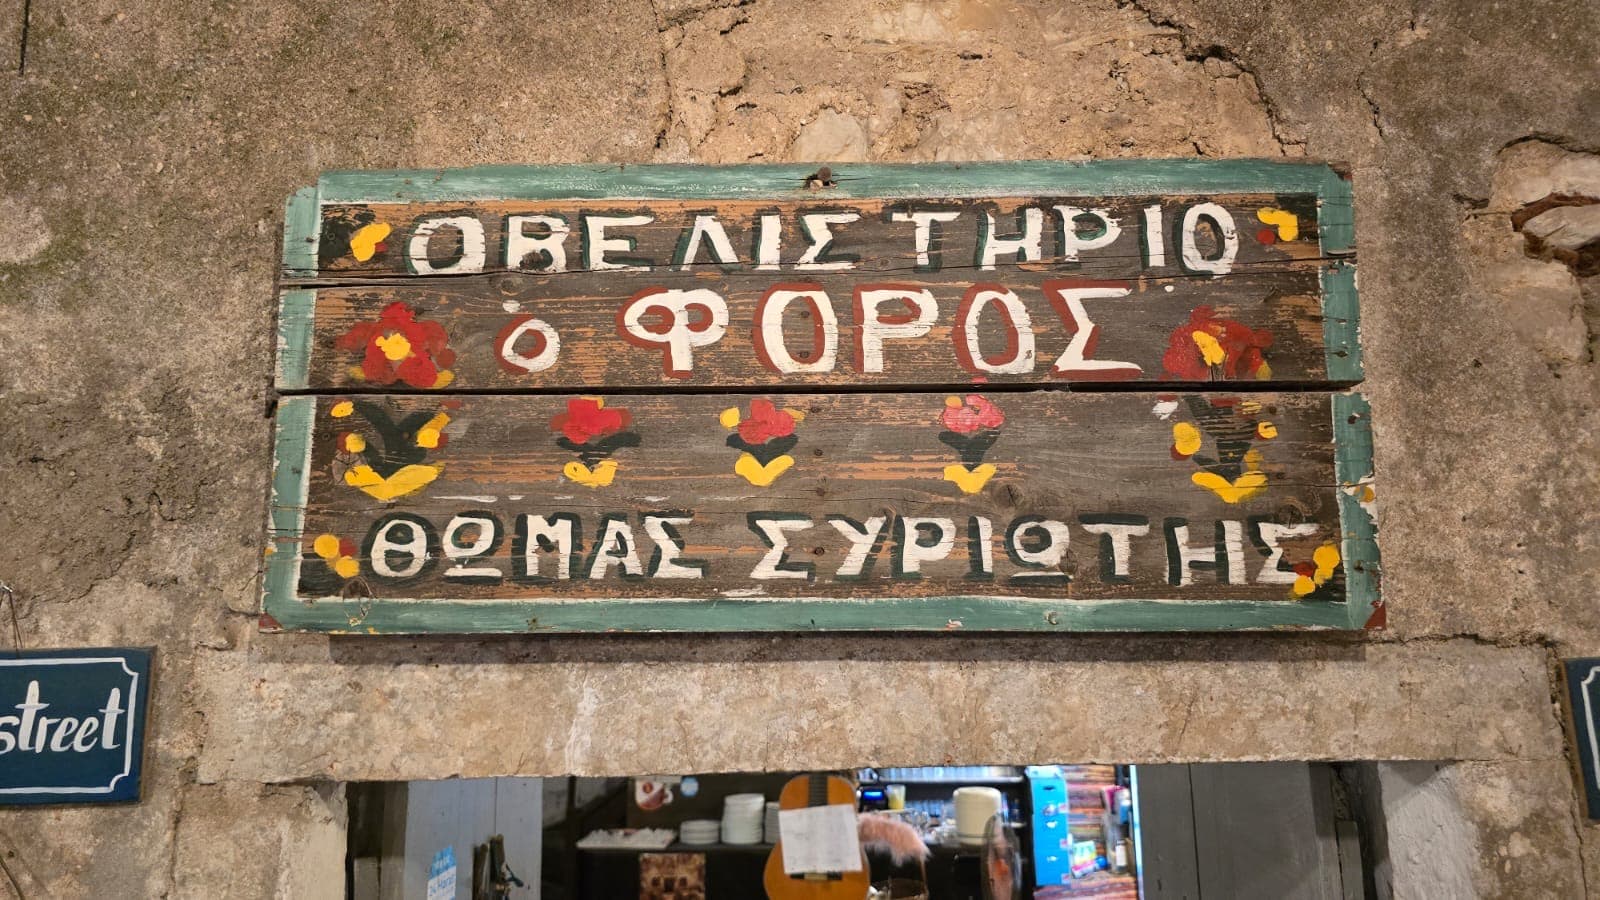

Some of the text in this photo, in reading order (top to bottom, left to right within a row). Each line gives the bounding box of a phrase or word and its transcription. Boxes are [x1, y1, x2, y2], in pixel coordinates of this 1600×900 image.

[621, 285, 1143, 376] ΦΟΡΟΣ
[369, 514, 1322, 586] ΘΩΜΑΣ ΣΥΡΙΩΤΗΣ
[0, 680, 126, 755] street
